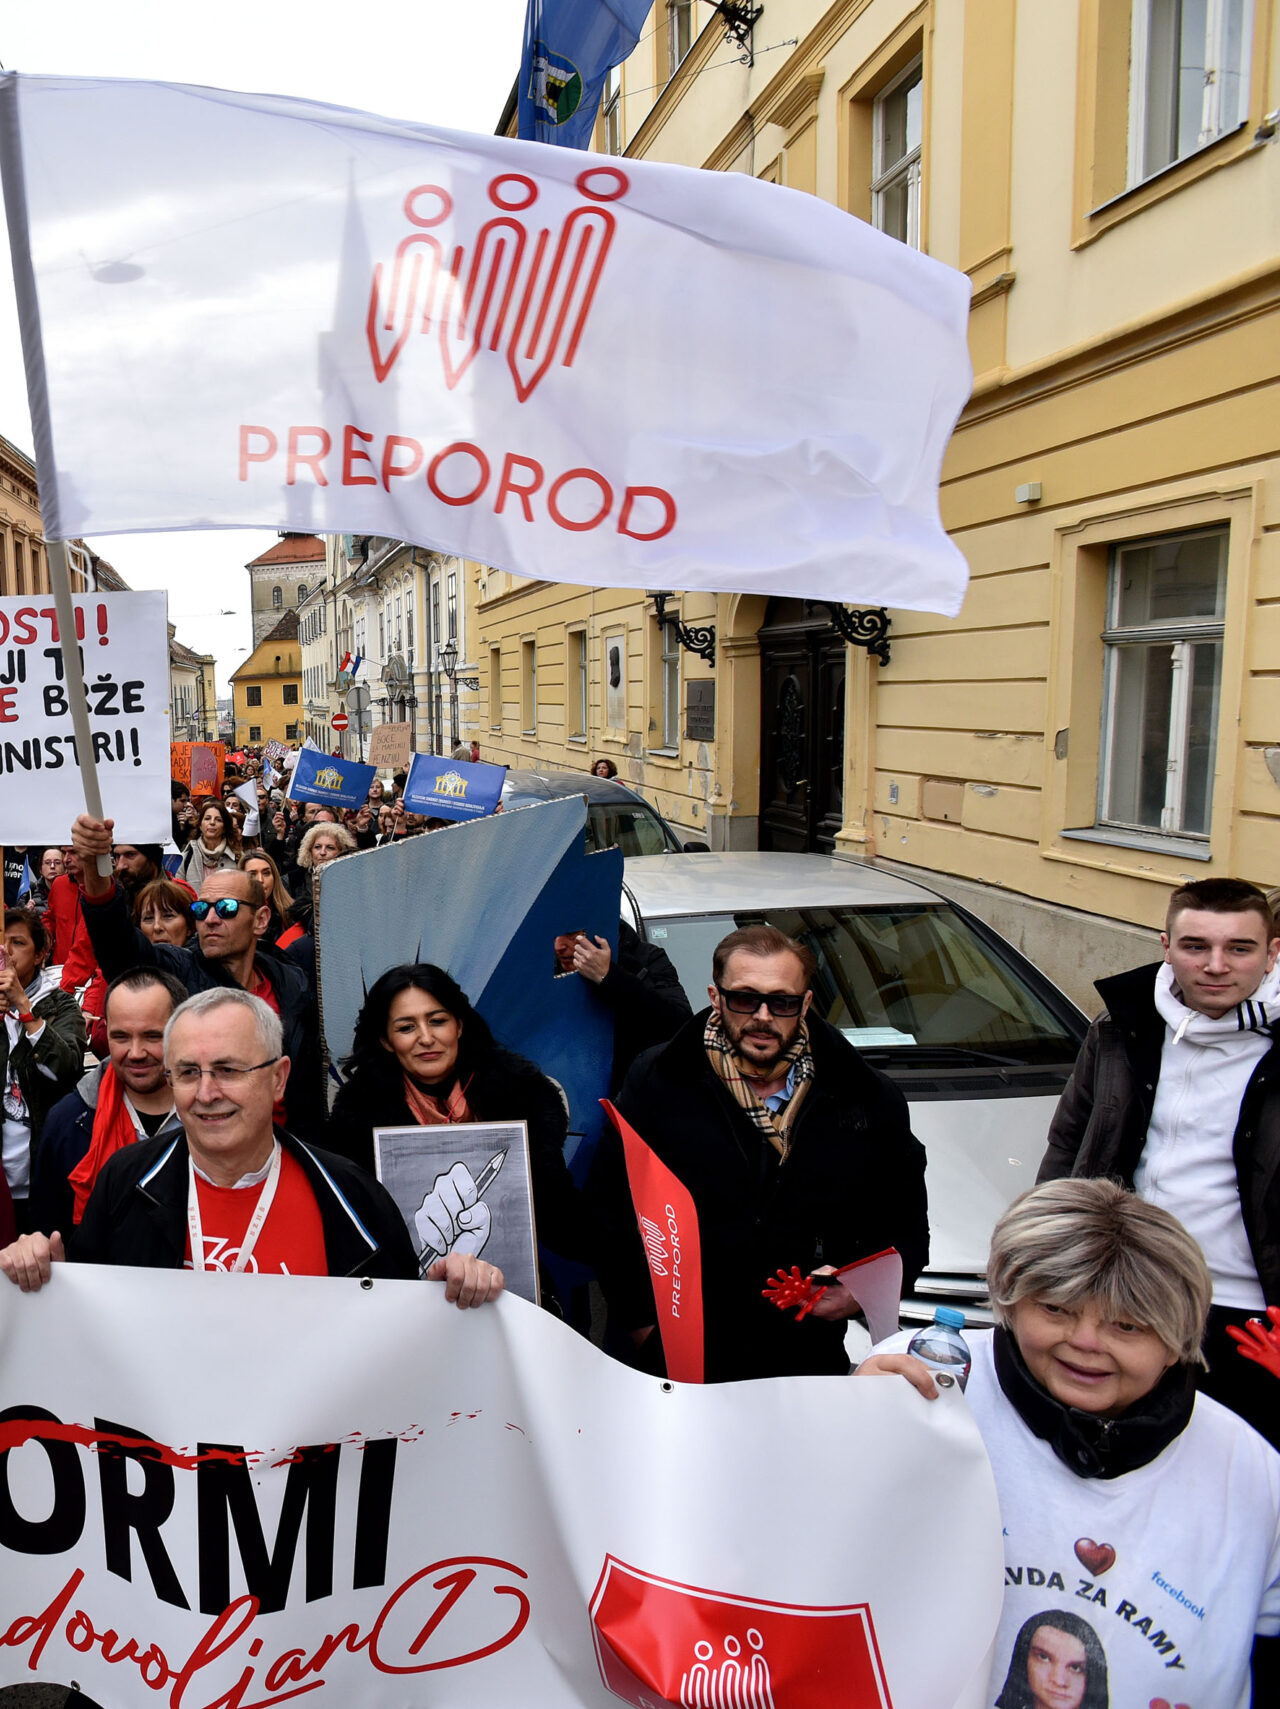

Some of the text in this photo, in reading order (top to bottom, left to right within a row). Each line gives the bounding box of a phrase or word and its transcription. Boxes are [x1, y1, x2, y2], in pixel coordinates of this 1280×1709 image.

[238, 424, 678, 542] PREPOROD
[665, 1203, 681, 1318] PREPOROD
[1075, 1579, 1108, 1608] ZA
[1115, 1599, 1186, 1670] RAMY
[1150, 1571, 1206, 1621] facebook
